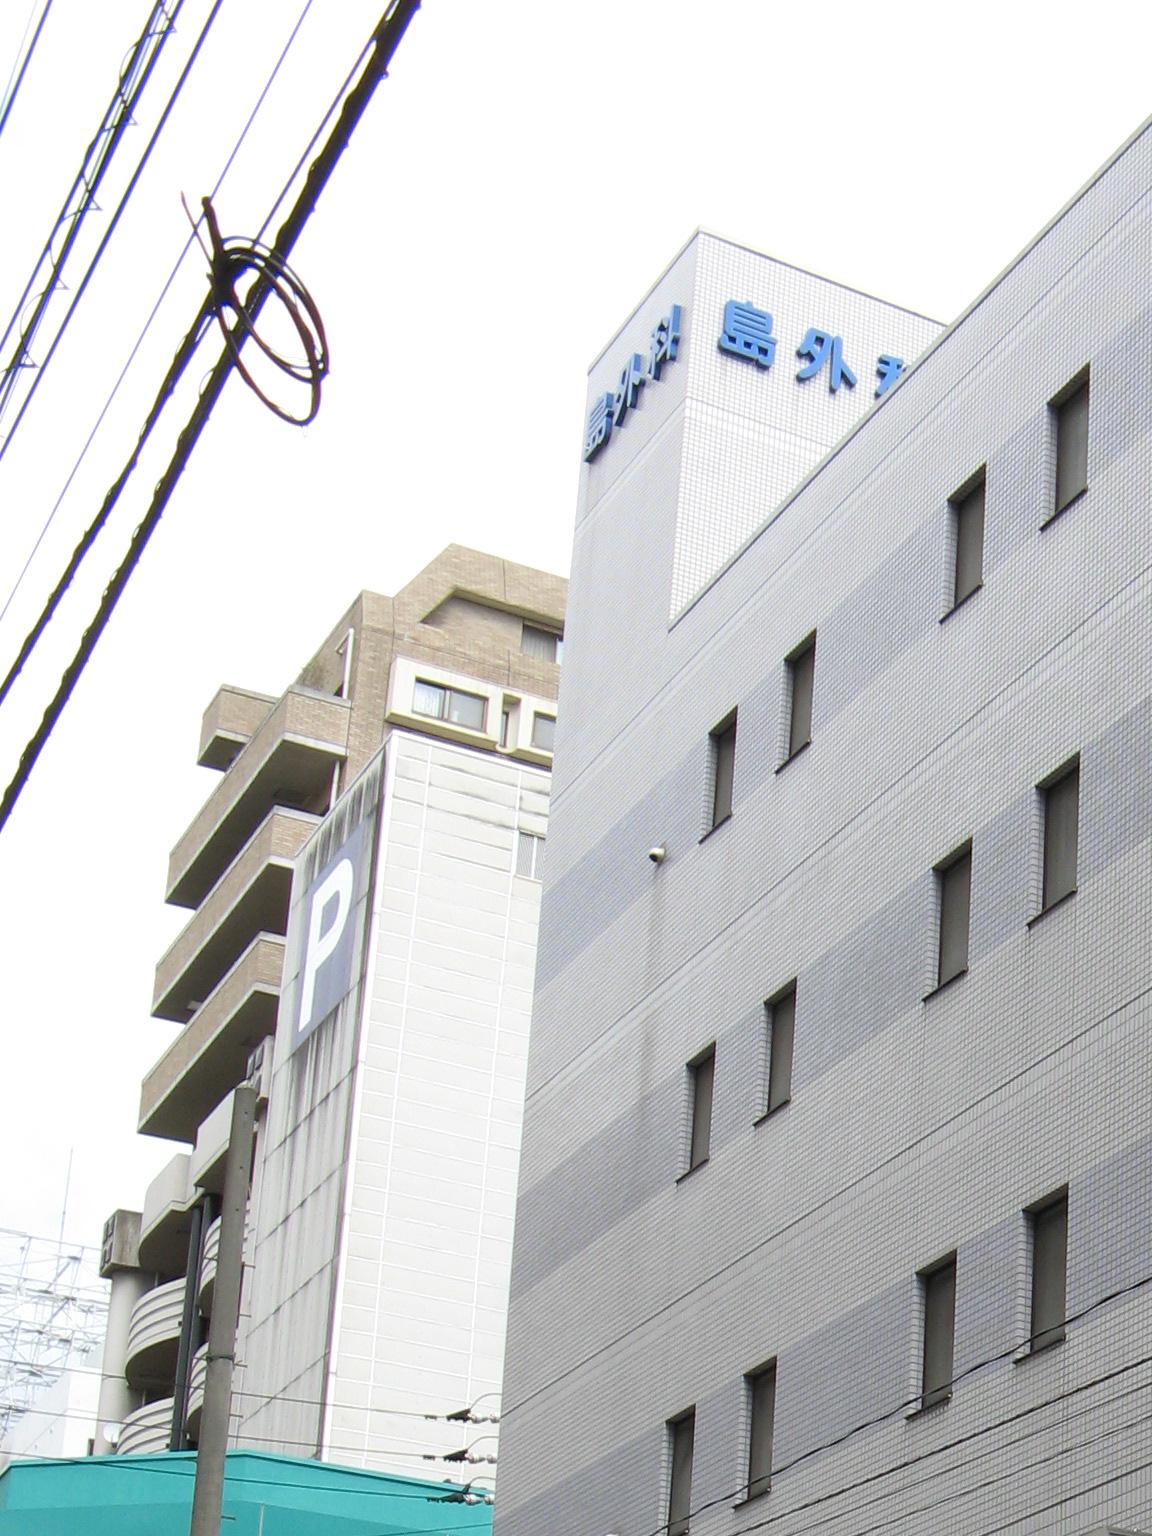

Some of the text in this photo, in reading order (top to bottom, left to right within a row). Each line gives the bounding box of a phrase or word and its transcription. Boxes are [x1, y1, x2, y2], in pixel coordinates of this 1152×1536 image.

[583, 303, 681, 462] 島外科
[298, 858, 354, 1032] P
